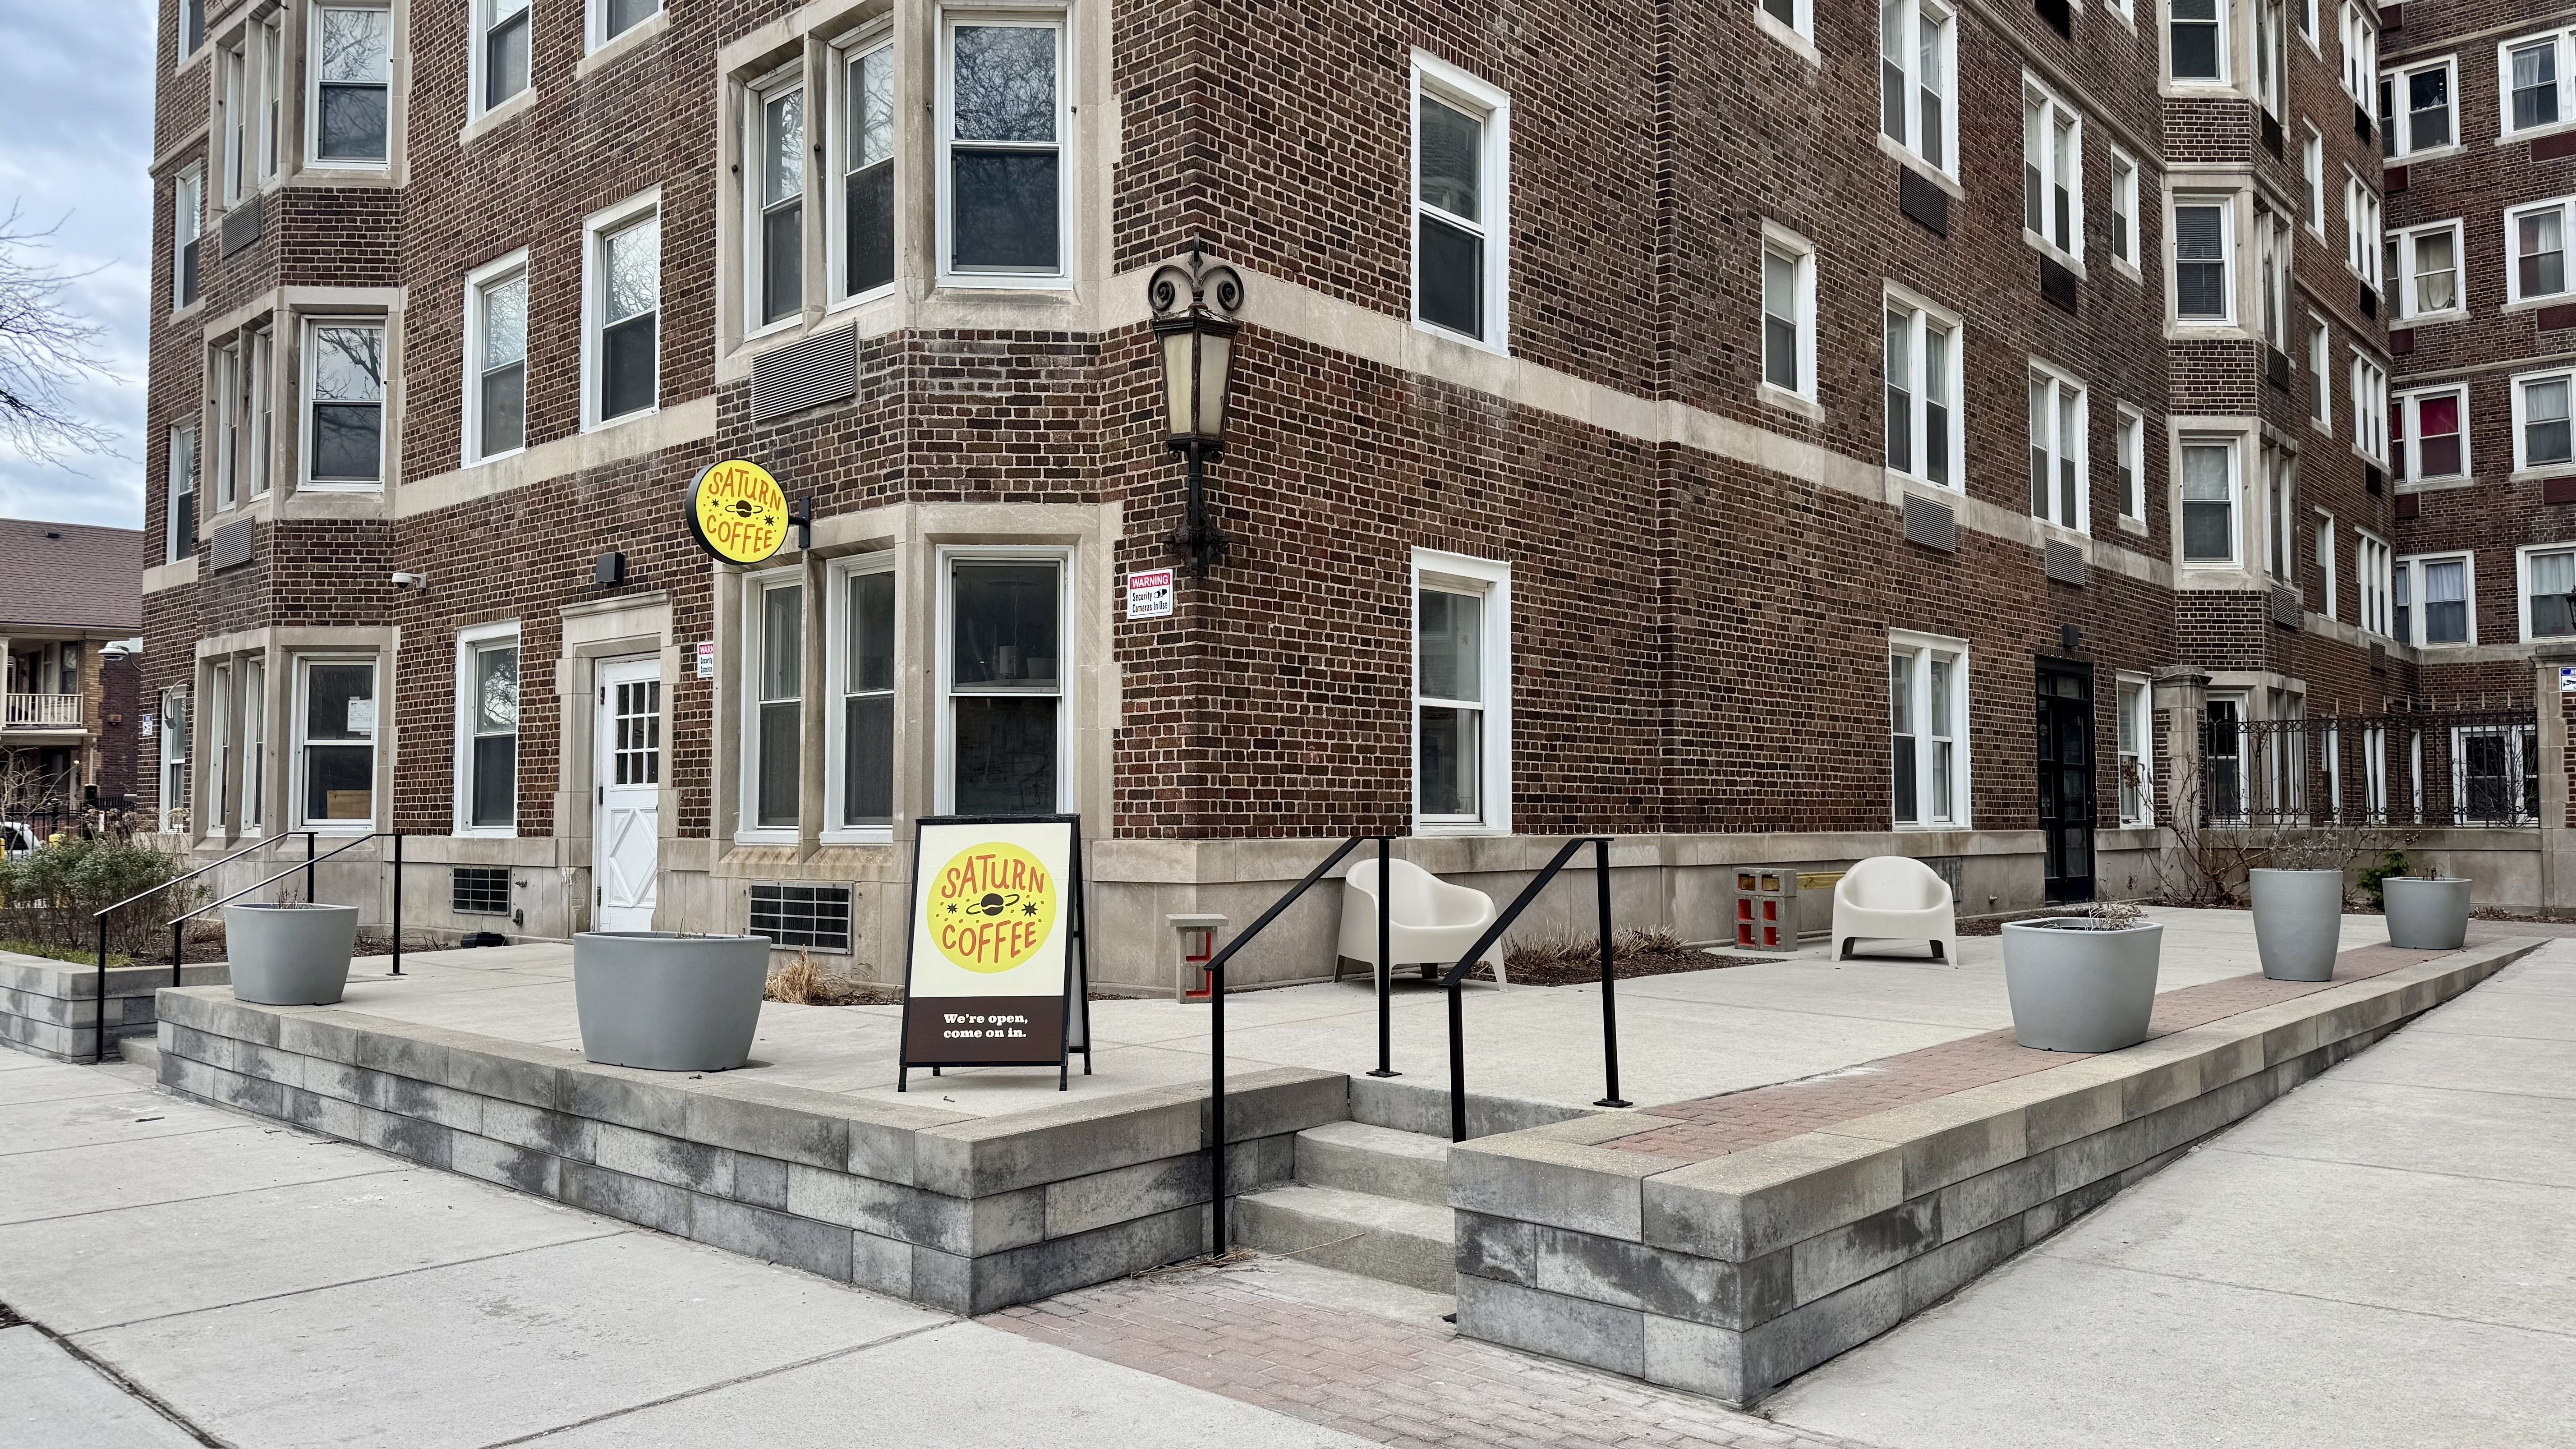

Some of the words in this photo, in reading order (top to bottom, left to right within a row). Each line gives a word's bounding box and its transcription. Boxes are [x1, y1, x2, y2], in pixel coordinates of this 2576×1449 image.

[708, 467, 781, 511] SATURN
[707, 515, 772, 554] COFFEE
[1132, 575, 1168, 588] WARNING
[1132, 591, 1152, 601] Security
[1132, 604, 1152, 613] Cameras
[1154, 602, 1158, 610] In
[1159, 601, 1168, 610] Use
[941, 854, 1044, 898] SATURN
[942, 920, 1036, 963] COFFEE
[943, 1013, 985, 1024] We're
[988, 1015, 1028, 1026] open,
[985, 1030, 1004, 1038] on
[1007, 1027, 1026, 1038] in.
